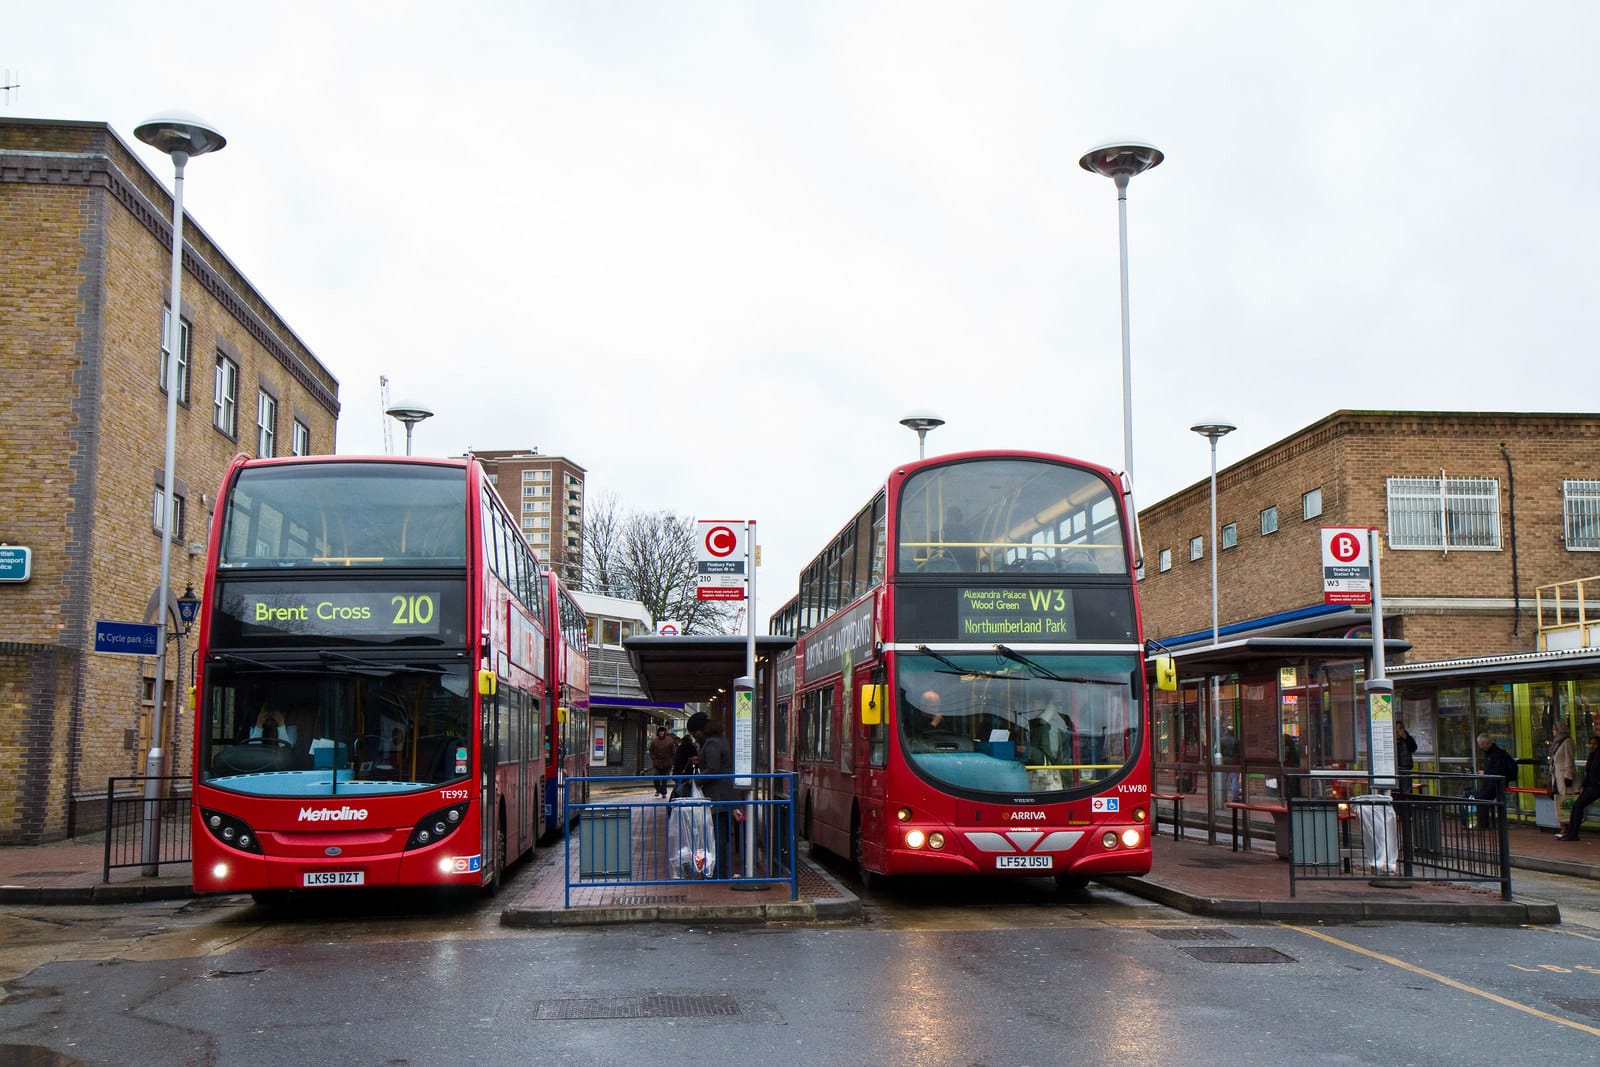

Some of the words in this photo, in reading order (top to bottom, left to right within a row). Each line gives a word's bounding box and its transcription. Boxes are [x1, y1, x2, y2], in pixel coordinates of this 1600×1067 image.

[709, 529, 730, 554] C
[1339, 537, 1354, 558] B
[963, 590, 1000, 599] Alexandra
[1003, 590, 1026, 599] Palace
[1029, 588, 1066, 612] W3
[255, 602, 308, 621] Brent
[316, 601, 371, 620] Cross
[391, 594, 434, 625] 210
[970, 600, 994, 609] Wood
[996, 600, 1020, 610] Green
[964, 618, 1042, 633] Northumberland
[1046, 618, 1067, 633] Park
[107, 633, 126, 643] Cycle
[126, 636, 142, 644] park
[440, 790, 469, 799] TE992
[1118, 784, 1147, 793] VLW80
[297, 806, 368, 822] Metroline
[1010, 811, 1046, 820] ARRIVA
[1000, 857, 1026, 867] LF52
[1029, 857, 1049, 867] USU
[307, 873, 336, 884] LK59
[339, 872, 360, 883] DZT
